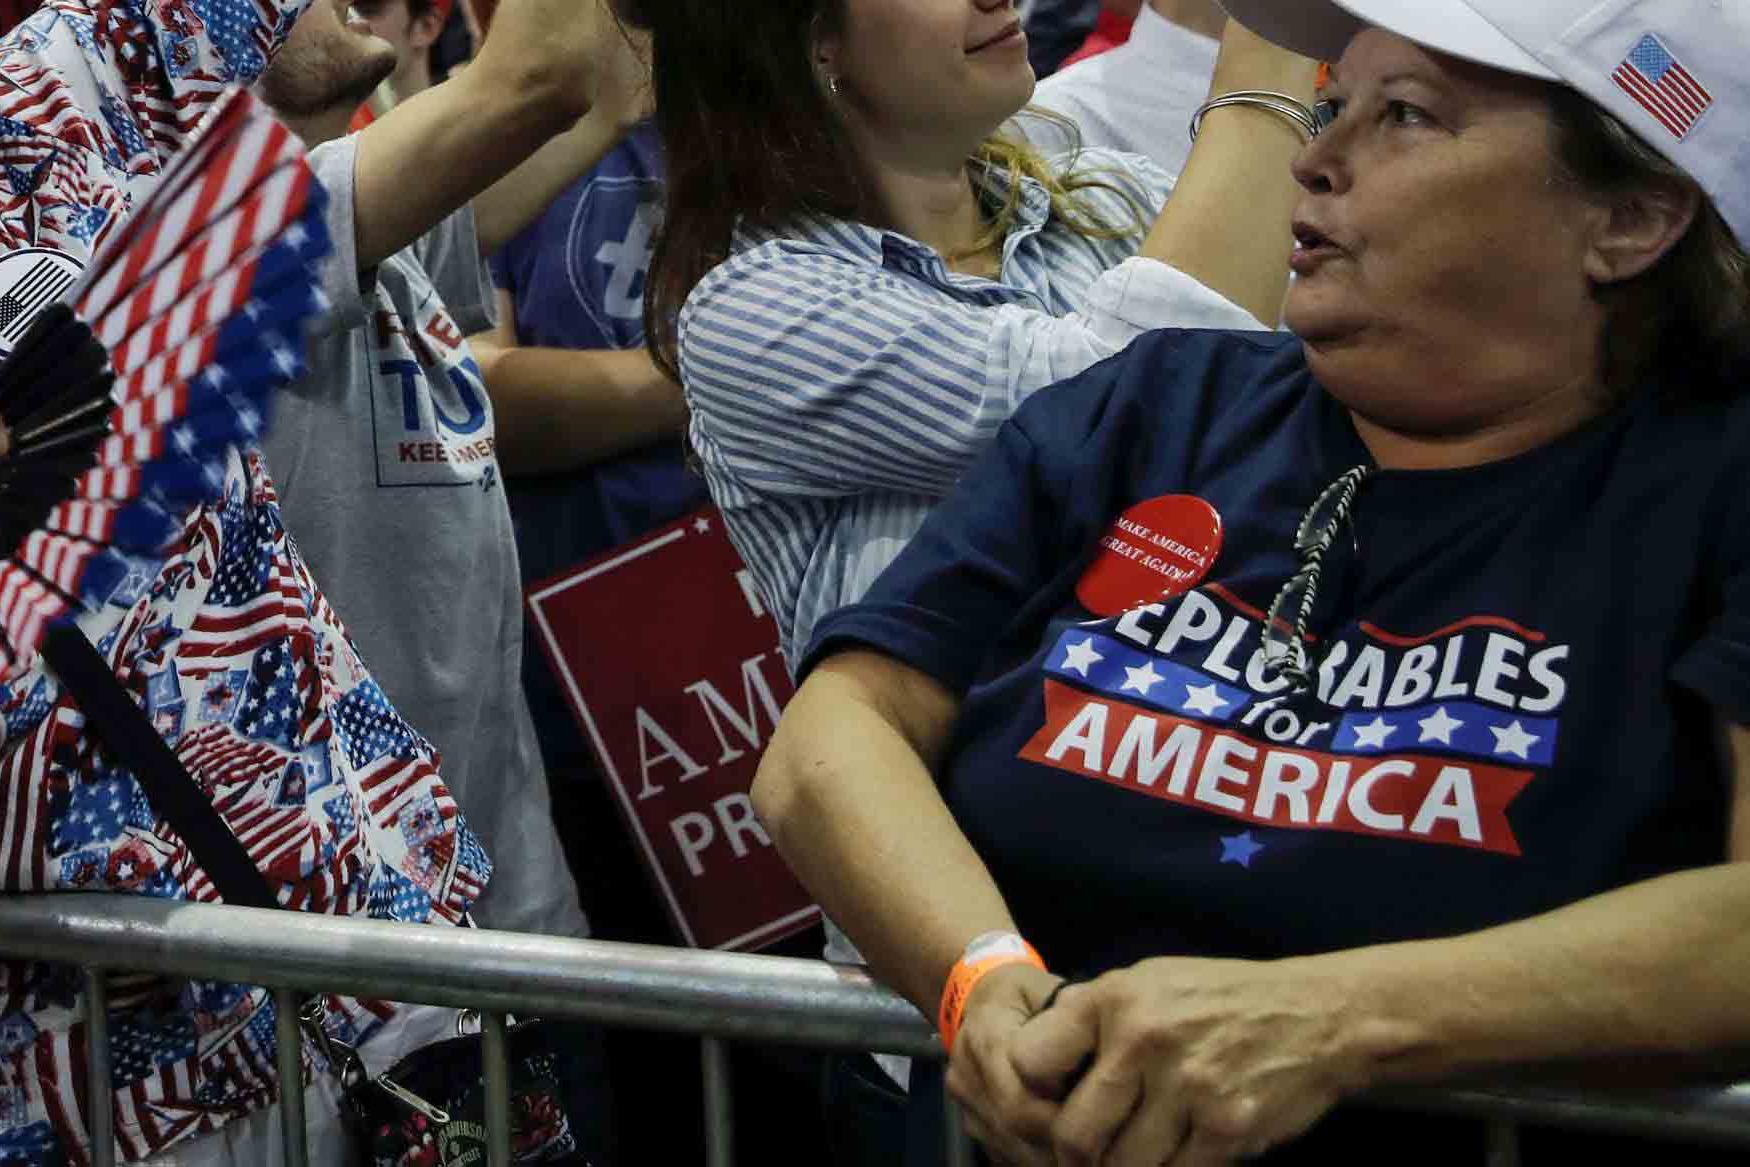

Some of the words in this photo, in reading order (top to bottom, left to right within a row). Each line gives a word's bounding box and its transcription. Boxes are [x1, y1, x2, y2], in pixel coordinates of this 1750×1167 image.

[397, 440, 449, 463] KEE
[456, 437, 496, 464] MER
[1101, 535, 1145, 561] GREAT
[1115, 516, 1149, 539] MAKE
[1148, 533, 1207, 568] AMERICA
[1078, 589, 1571, 713] EPLOABLES
[1045, 702, 1483, 843] AMERICA
